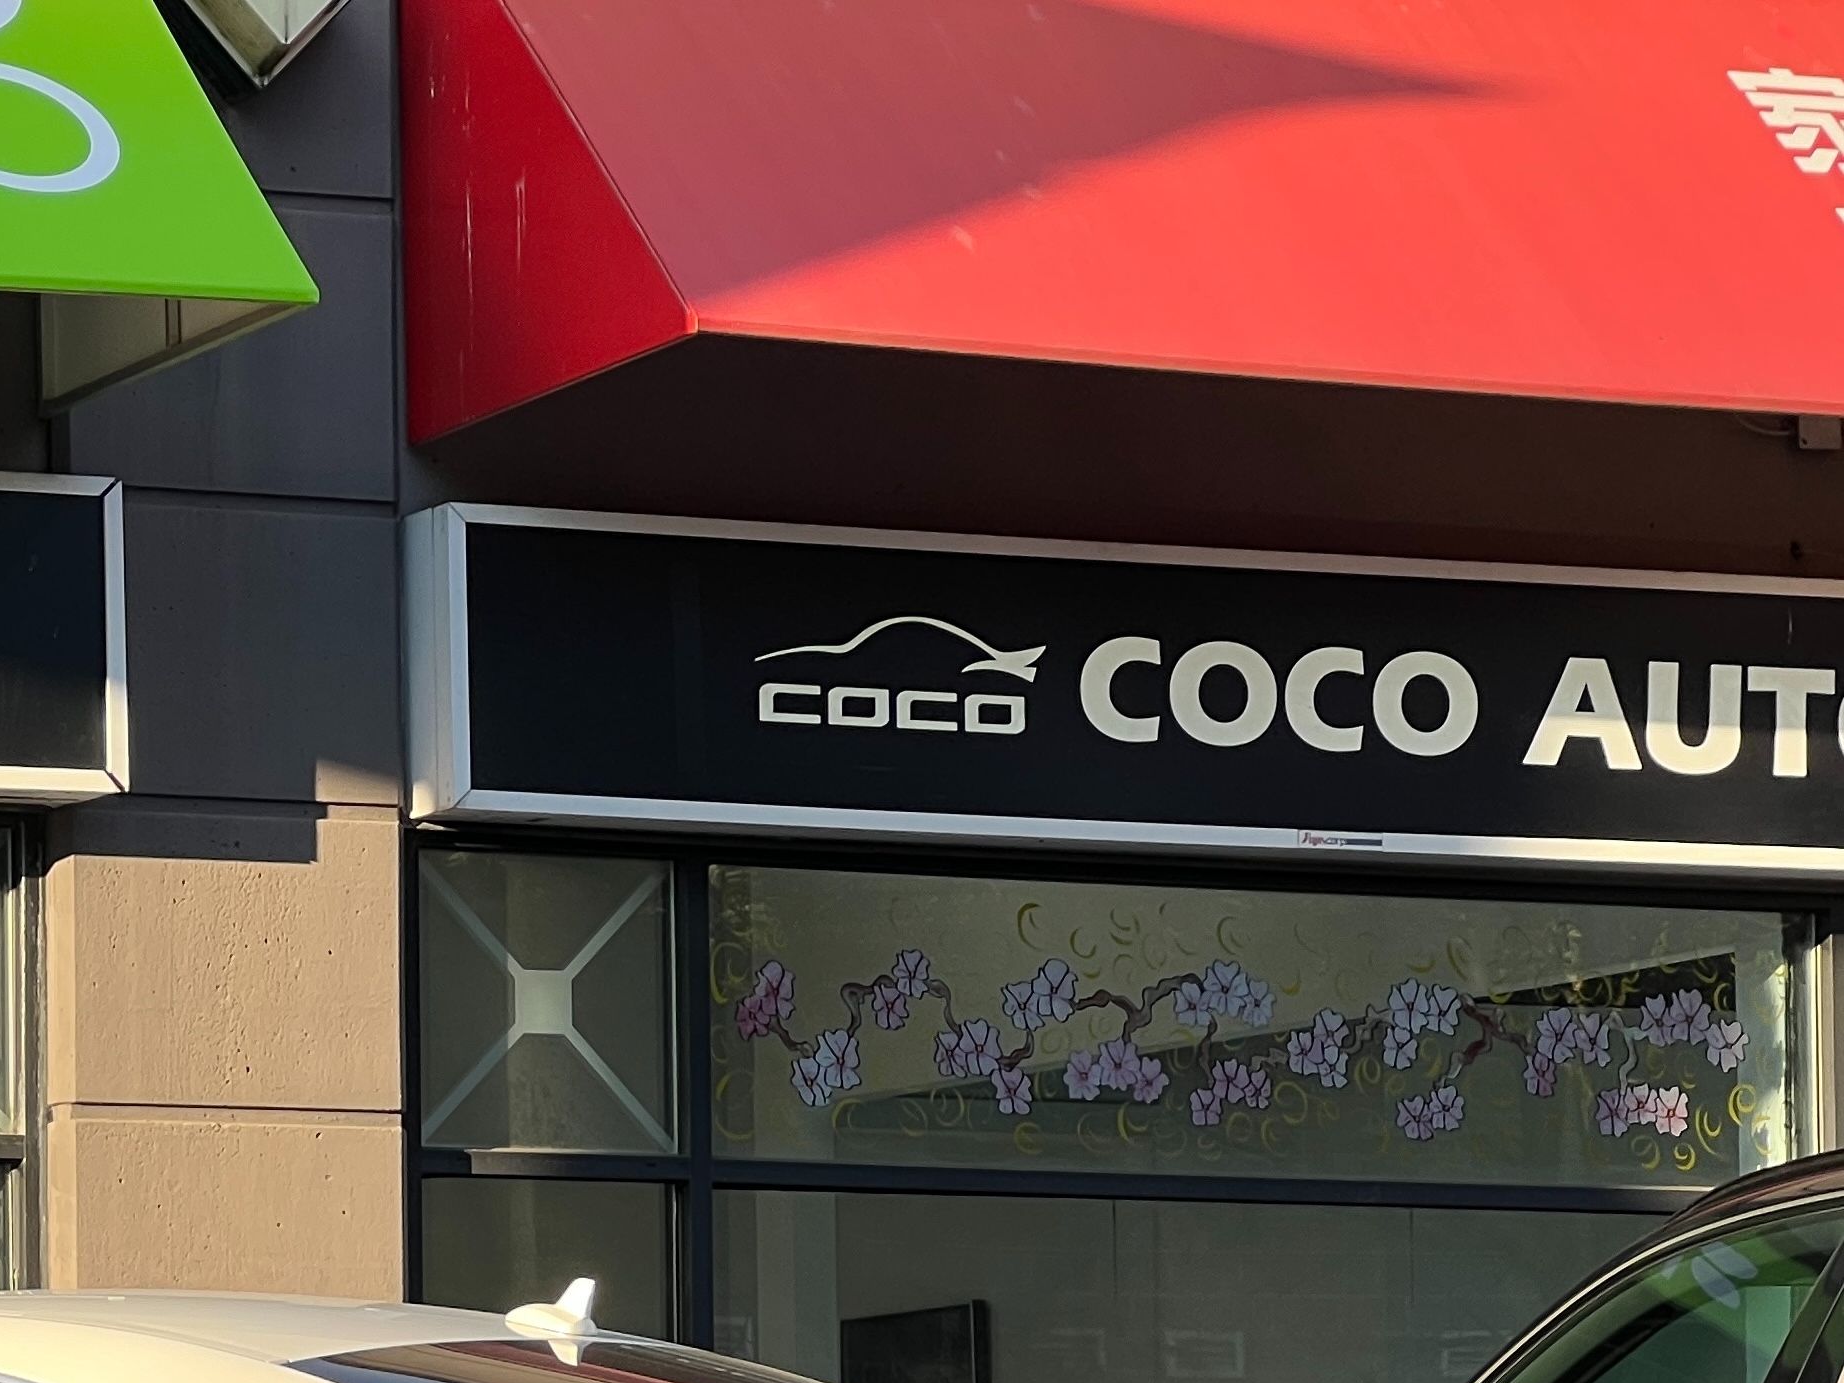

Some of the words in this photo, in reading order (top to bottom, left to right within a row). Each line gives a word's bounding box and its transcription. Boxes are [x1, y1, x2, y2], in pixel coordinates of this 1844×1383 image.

[758, 682, 1028, 736] COCO
[1079, 635, 1480, 757] COCO
[1522, 655, 1844, 779] AUT
